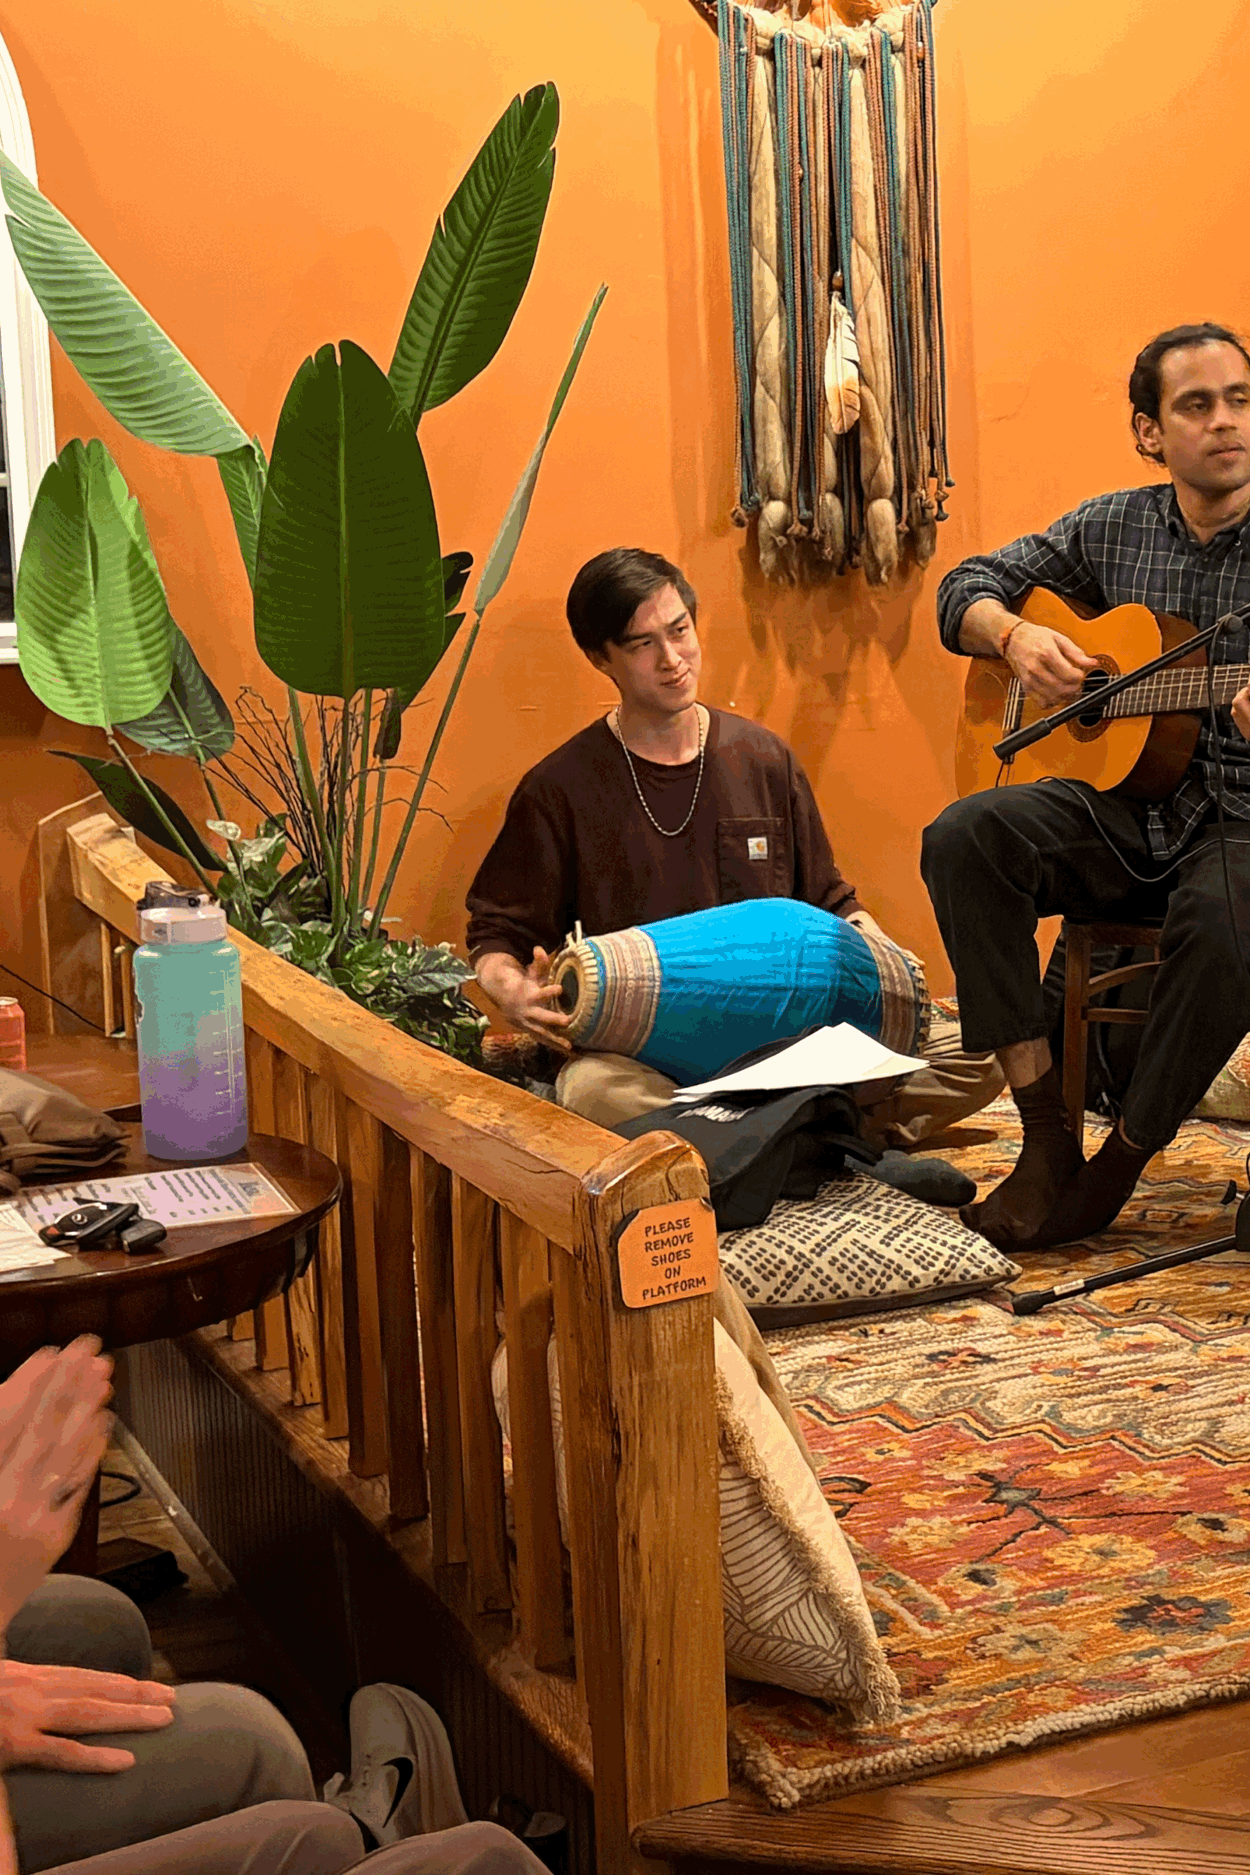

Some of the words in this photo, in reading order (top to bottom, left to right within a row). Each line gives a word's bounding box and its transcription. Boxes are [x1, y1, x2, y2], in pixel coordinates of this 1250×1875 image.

[645, 1218, 691, 1237] PLEASE
[645, 1233, 694, 1252] REMOVE
[651, 1249, 691, 1266] SHOES
[665, 1265, 681, 1279] ON
[643, 1277, 706, 1299] PLATFORM
